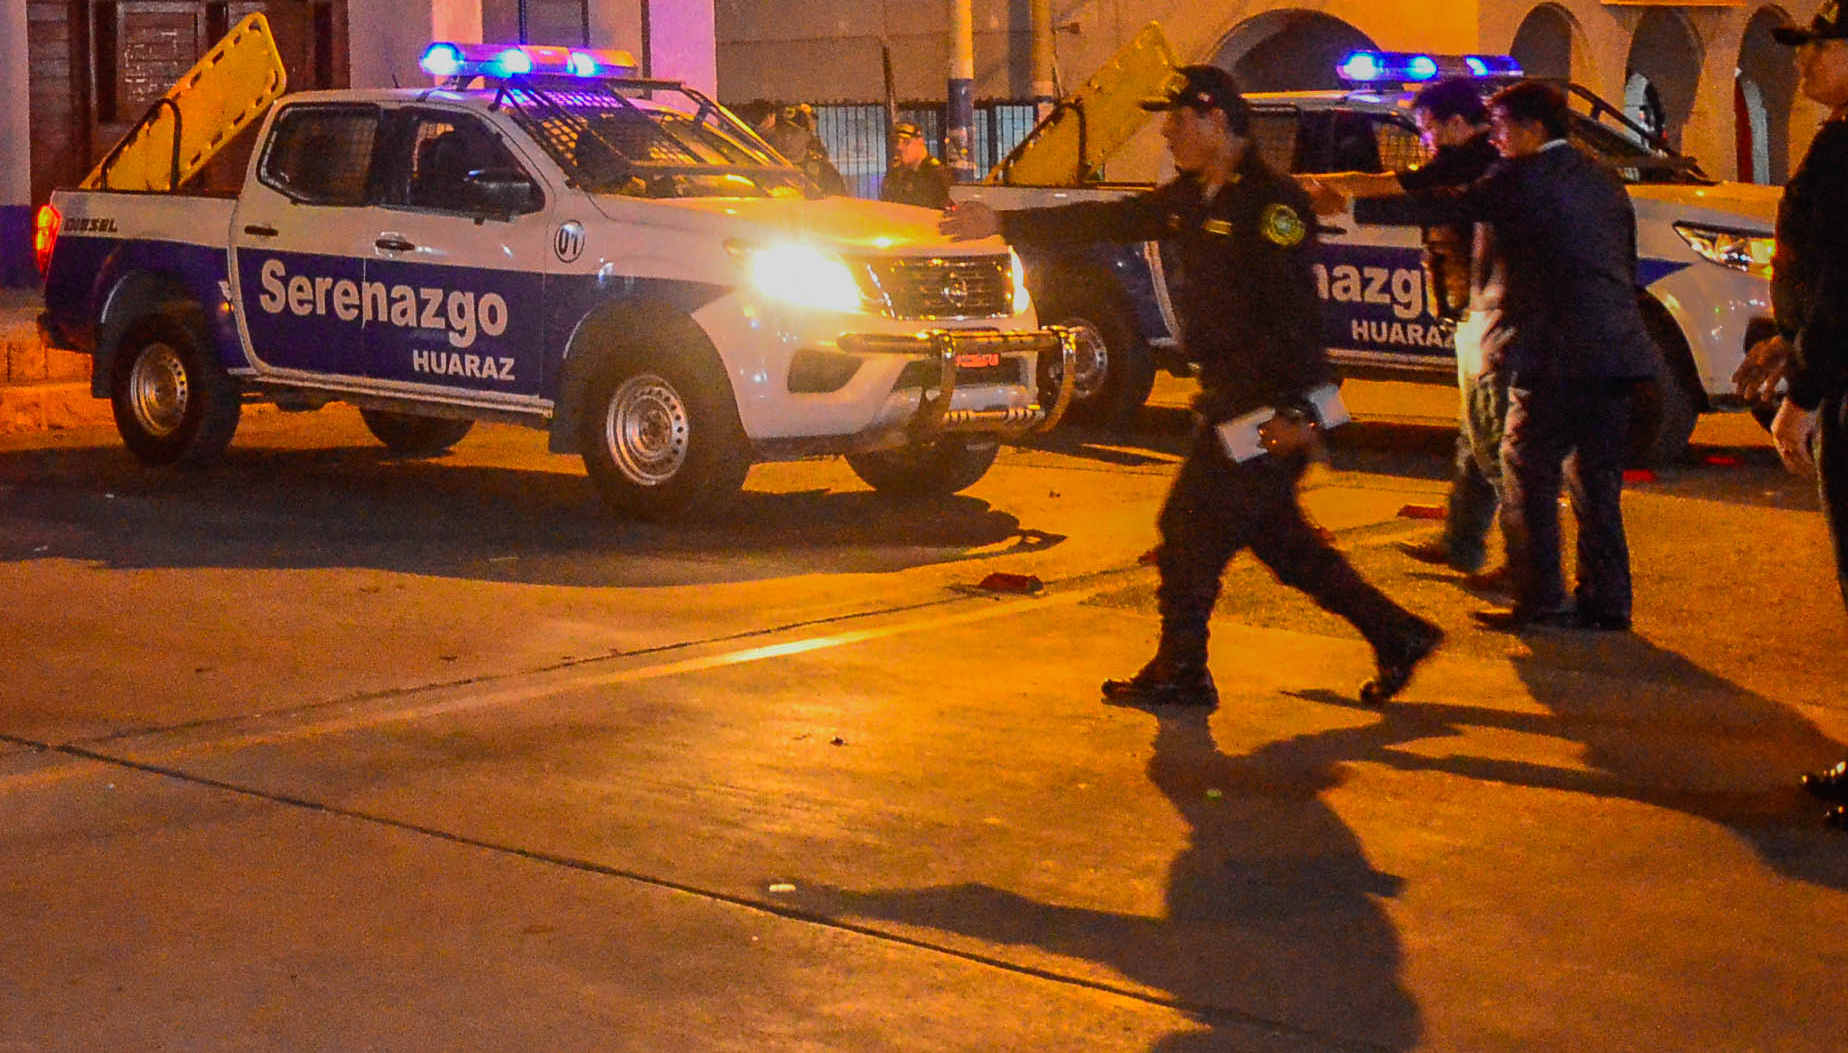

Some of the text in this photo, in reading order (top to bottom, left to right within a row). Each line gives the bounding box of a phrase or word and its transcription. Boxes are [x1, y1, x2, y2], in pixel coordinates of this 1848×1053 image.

[63, 217, 118, 233] DIESEL
[259, 258, 509, 348] Serenazgo
[413, 349, 516, 382] HUARAZ
